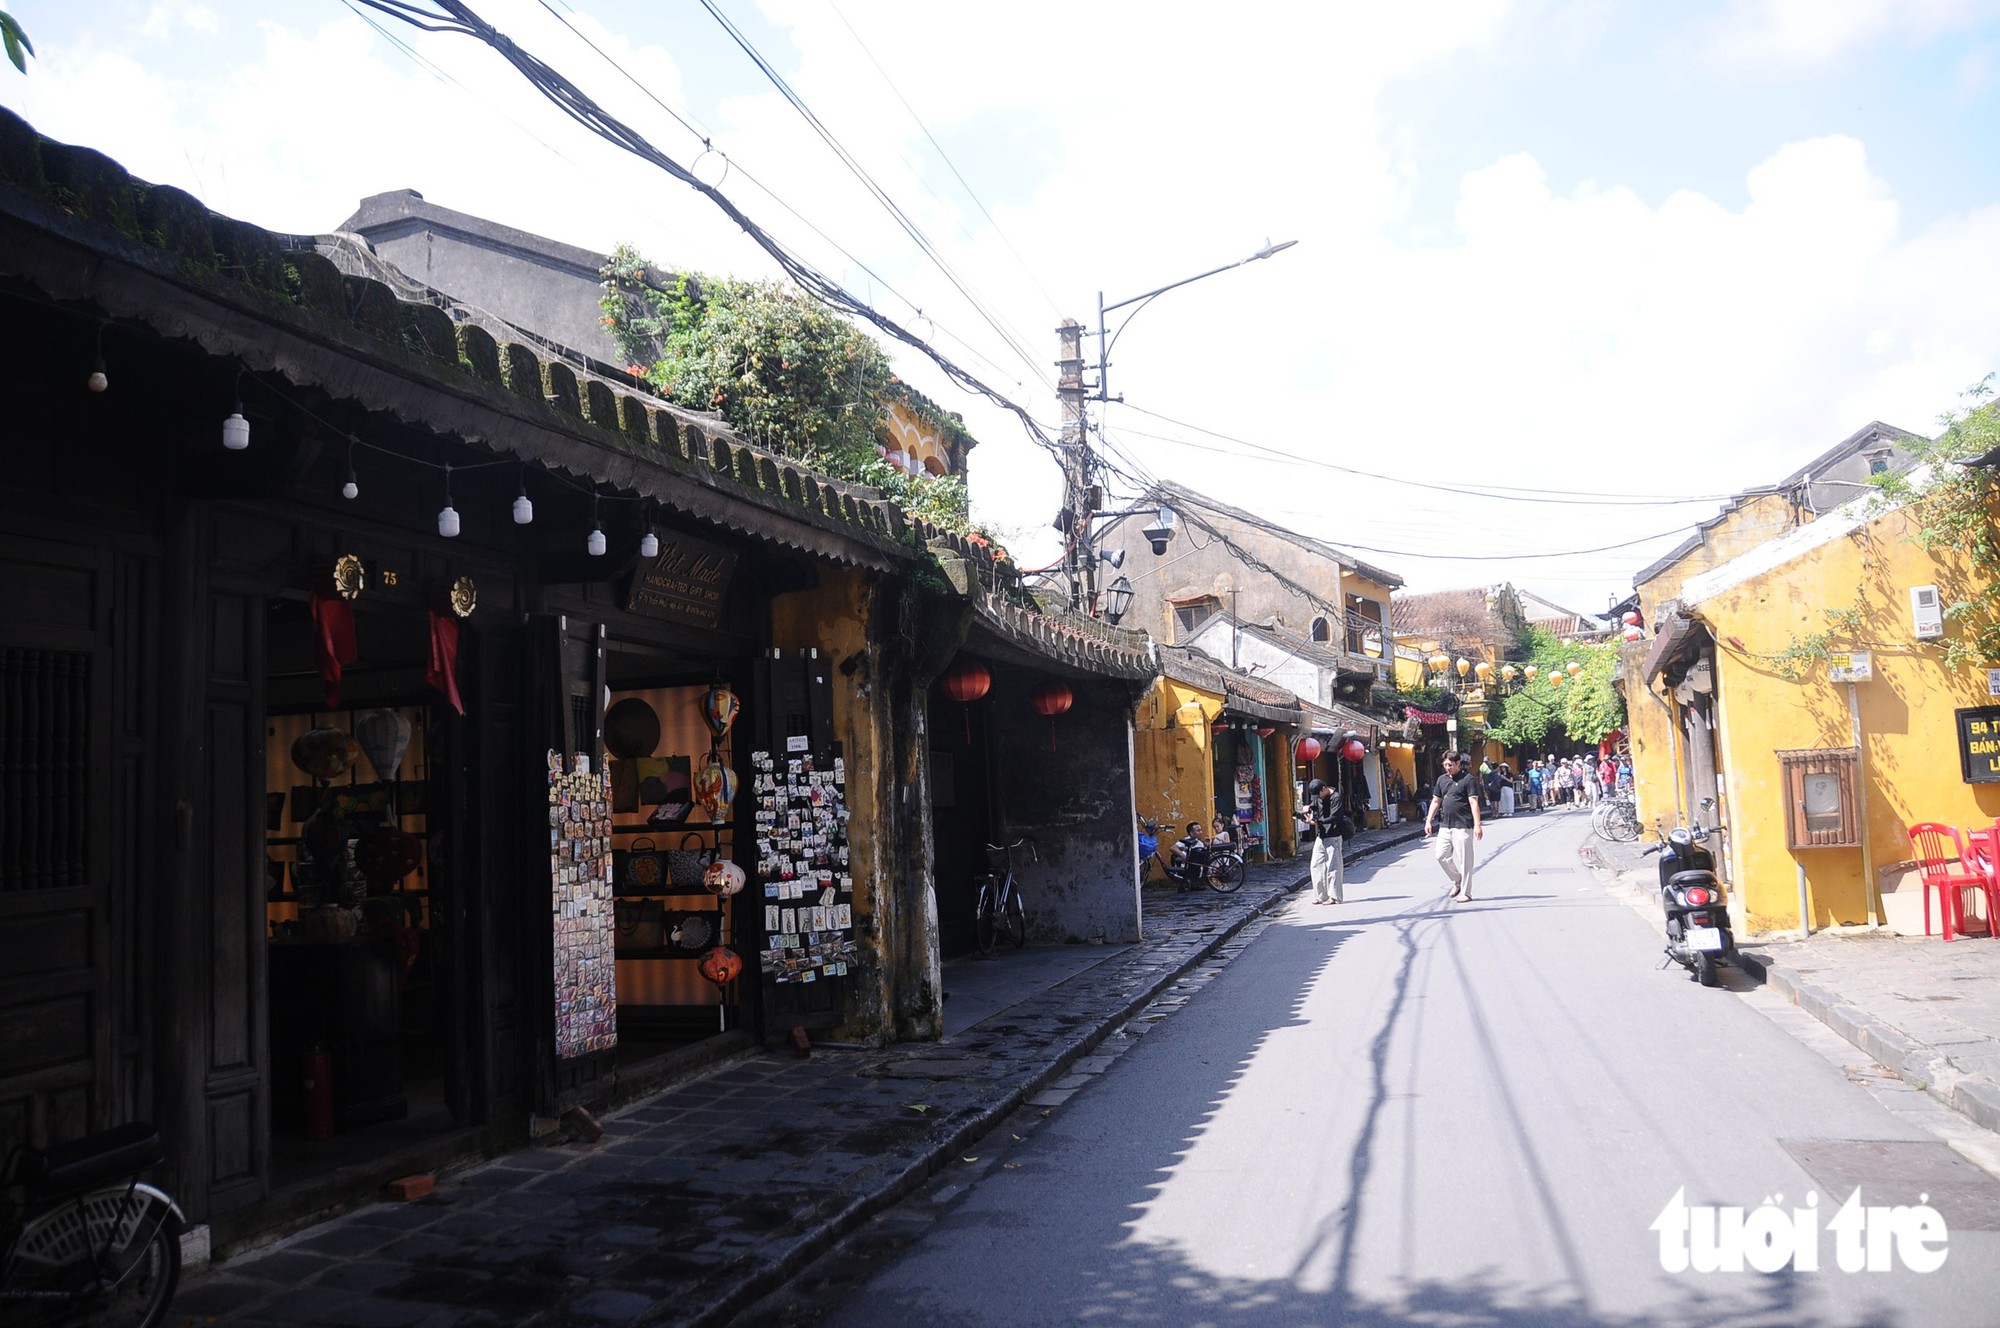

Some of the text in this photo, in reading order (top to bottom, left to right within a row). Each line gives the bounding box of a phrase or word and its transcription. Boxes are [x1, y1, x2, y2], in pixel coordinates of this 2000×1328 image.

[383, 571, 397, 586] 75
[683, 554, 724, 585] Made
[645, 573, 719, 601] HANDCRAFTED GIFT SHOP
[1971, 720, 2000, 734] 94 T
